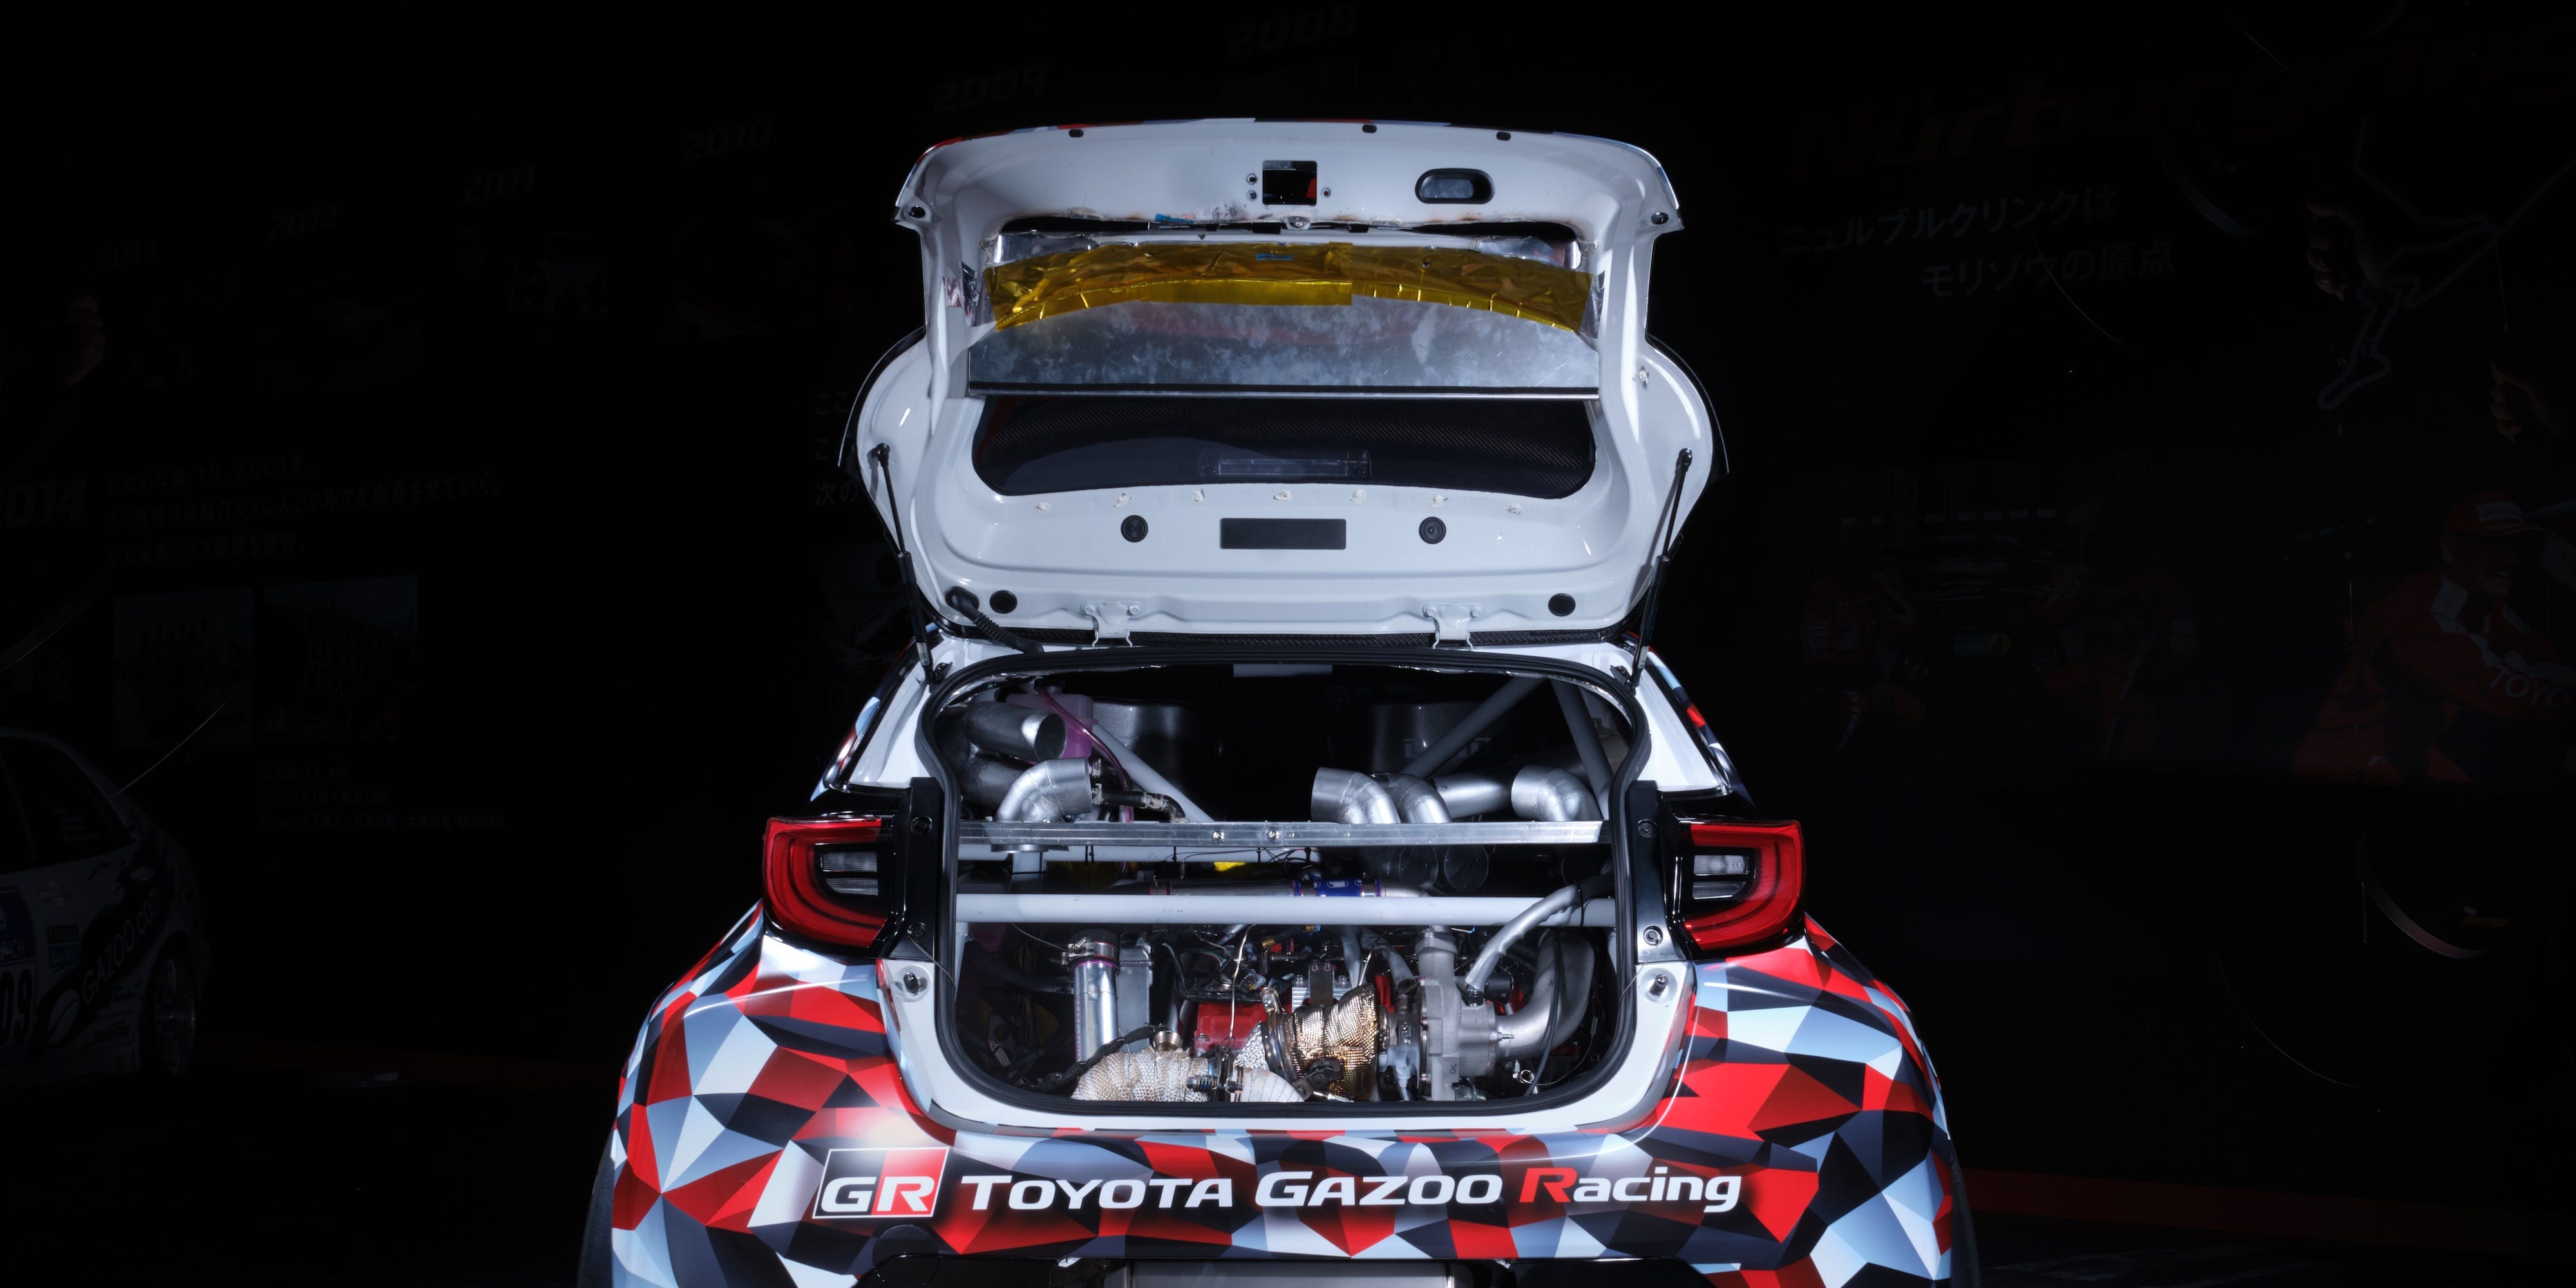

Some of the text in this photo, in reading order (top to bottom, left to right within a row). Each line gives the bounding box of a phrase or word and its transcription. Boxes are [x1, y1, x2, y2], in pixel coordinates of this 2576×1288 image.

[1226, 1, 1361, 58] 2008
[932, 62, 1051, 115] 2009
[680, 118, 774, 162] 2010
[462, 165, 537, 204] 2011
[269, 202, 340, 241] 2012
[1777, 183, 2119, 257] ニュルブルクリンクは
[1921, 237, 2177, 299] モリゾウの原点
[0, 477, 88, 531] 014
[820, 1166, 1742, 1213] GR TOYOTA GAZOO Racing
